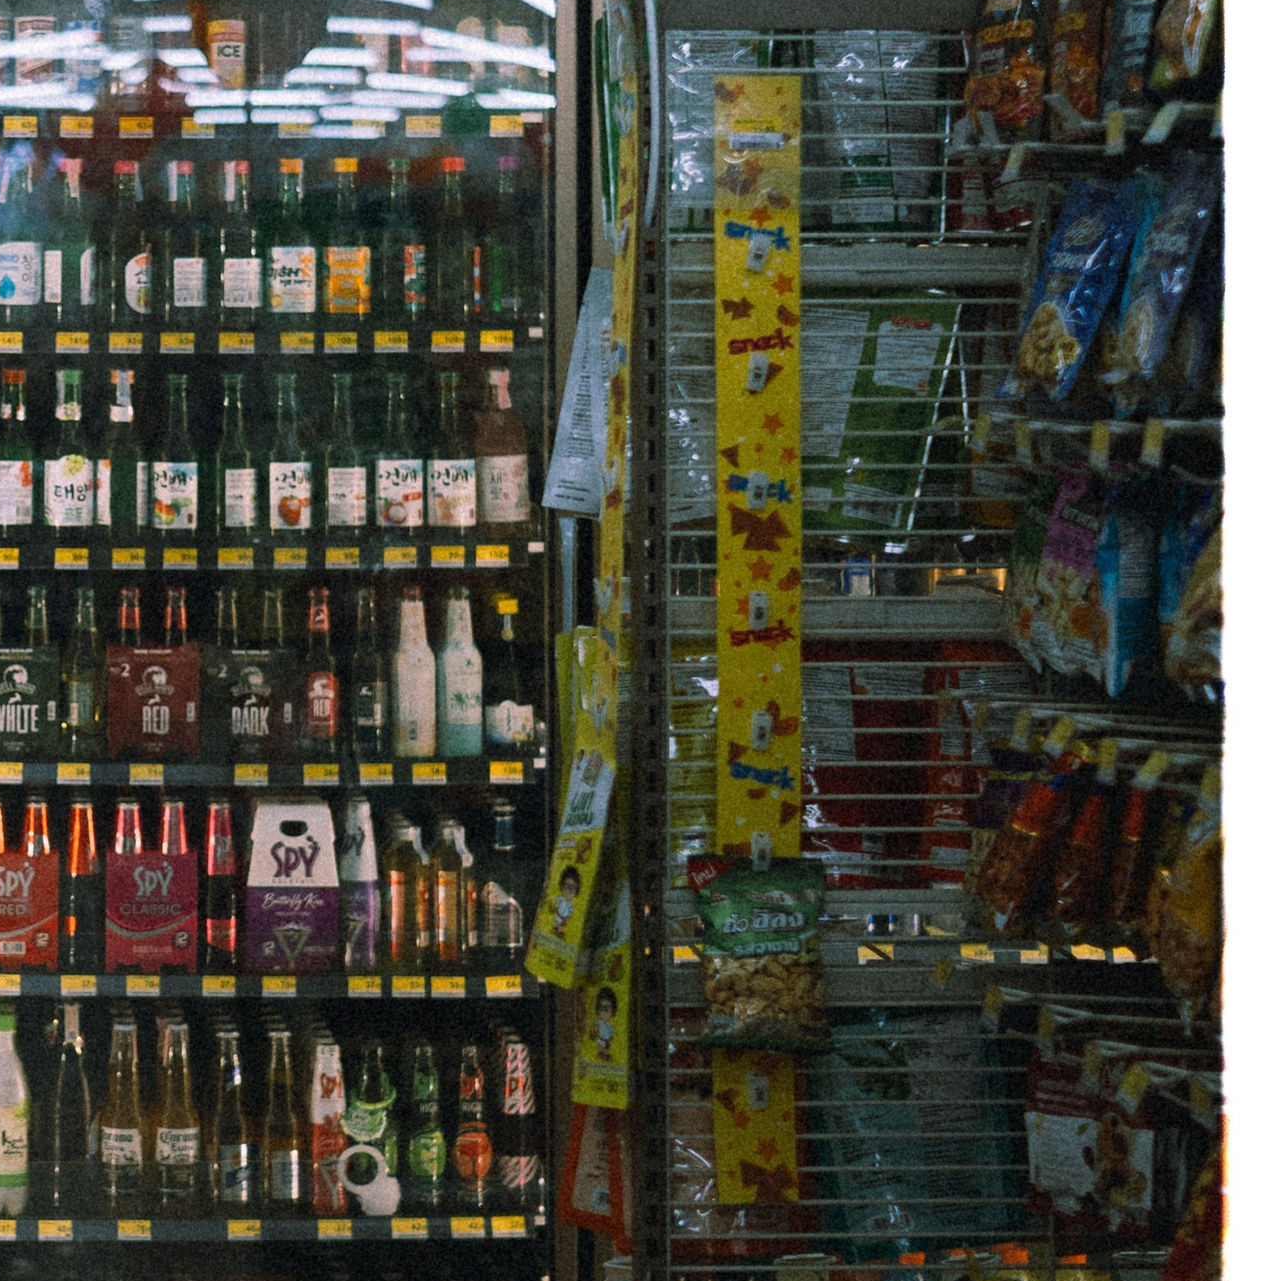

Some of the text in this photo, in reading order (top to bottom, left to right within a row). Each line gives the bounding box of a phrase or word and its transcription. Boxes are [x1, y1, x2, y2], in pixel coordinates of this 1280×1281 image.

[215, 45, 241, 60] ICE
[728, 328, 794, 355] snack
[121, 663, 131, 678] 2
[141, 706, 170, 734] RED
[231, 706, 270, 735] DARK
[269, 835, 321, 879] SPY
[132, 861, 175, 898] SPY
[119, 903, 181, 917] CLASSIC
[35, 931, 50, 948] 2
[175, 932, 189, 947] 2
